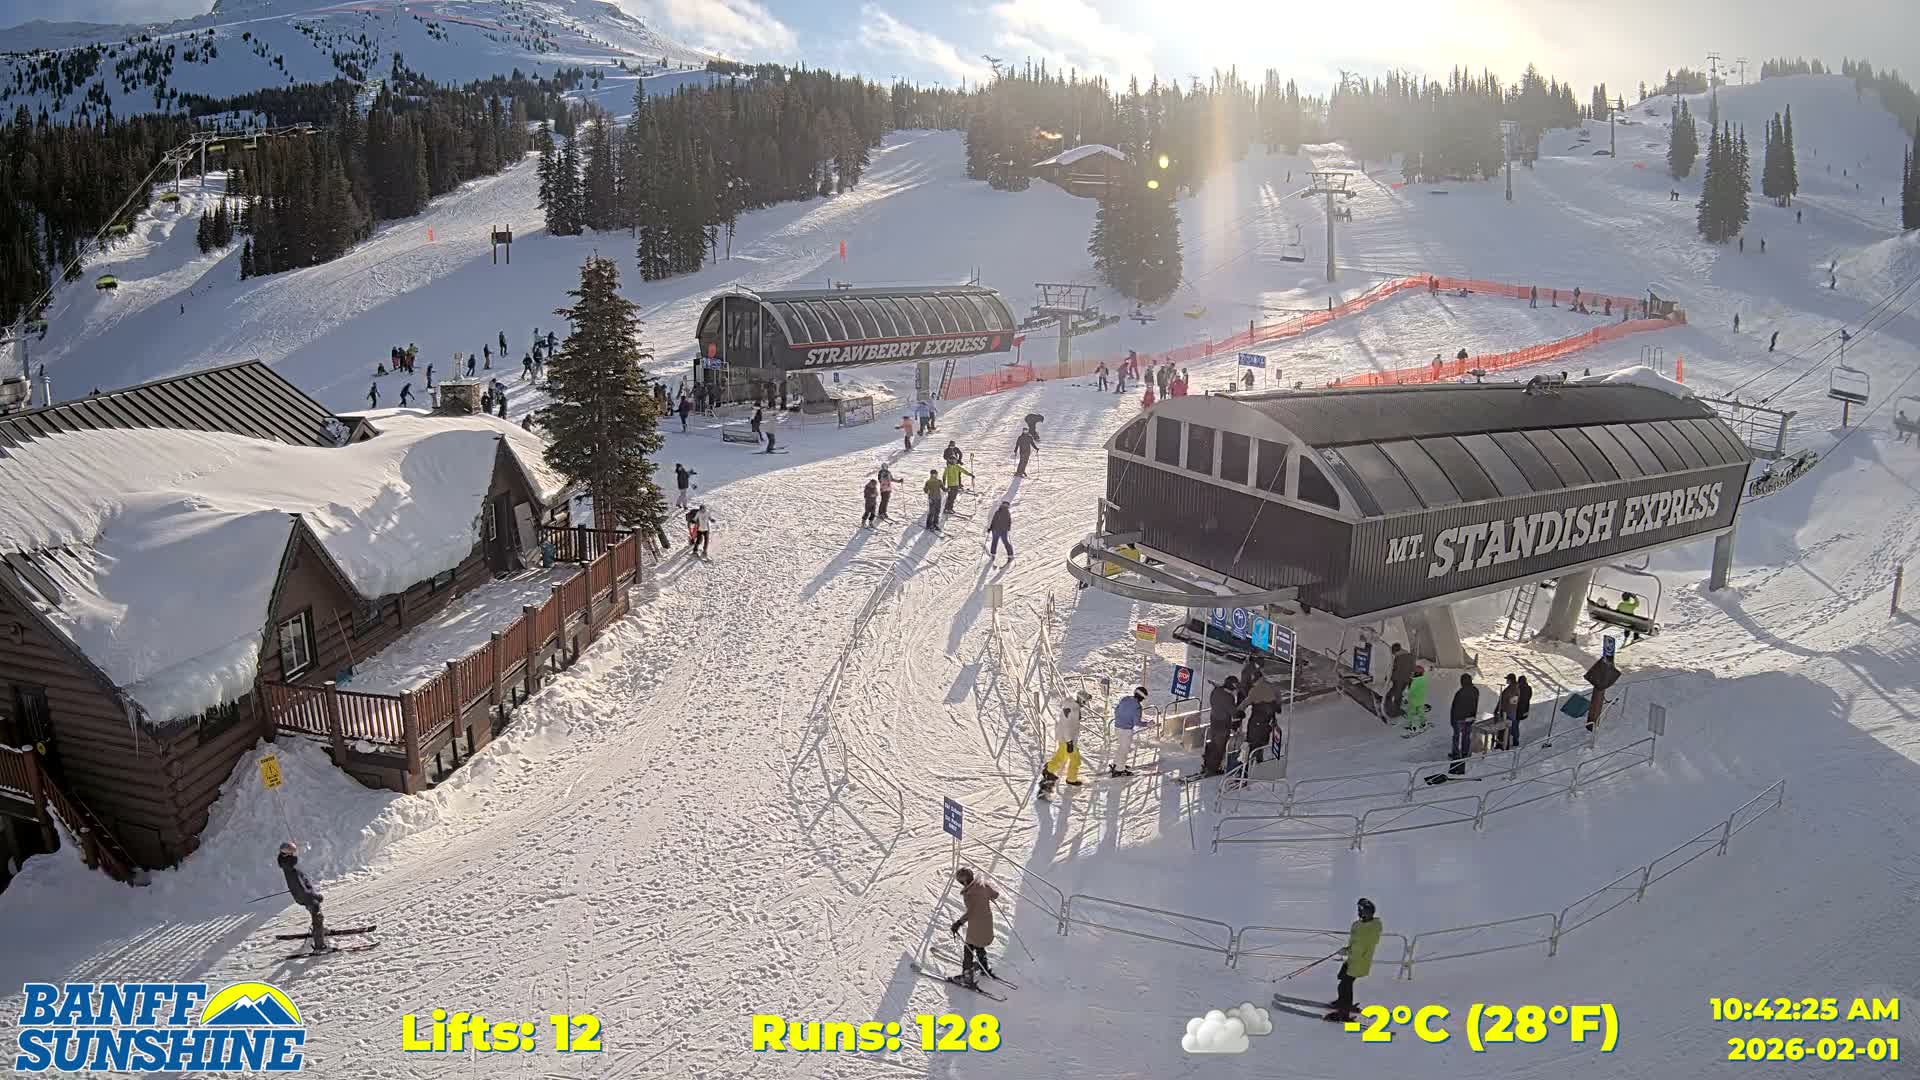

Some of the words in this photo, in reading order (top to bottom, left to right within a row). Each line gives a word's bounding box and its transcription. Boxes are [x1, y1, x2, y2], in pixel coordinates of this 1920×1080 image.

[805, 341, 920, 365] STRAWBERRY
[922, 337, 988, 355] EXPRESS
[1385, 533, 1425, 564] MT.
[1428, 500, 1618, 578] STANDISH
[1619, 482, 1723, 537] EXPRESS
